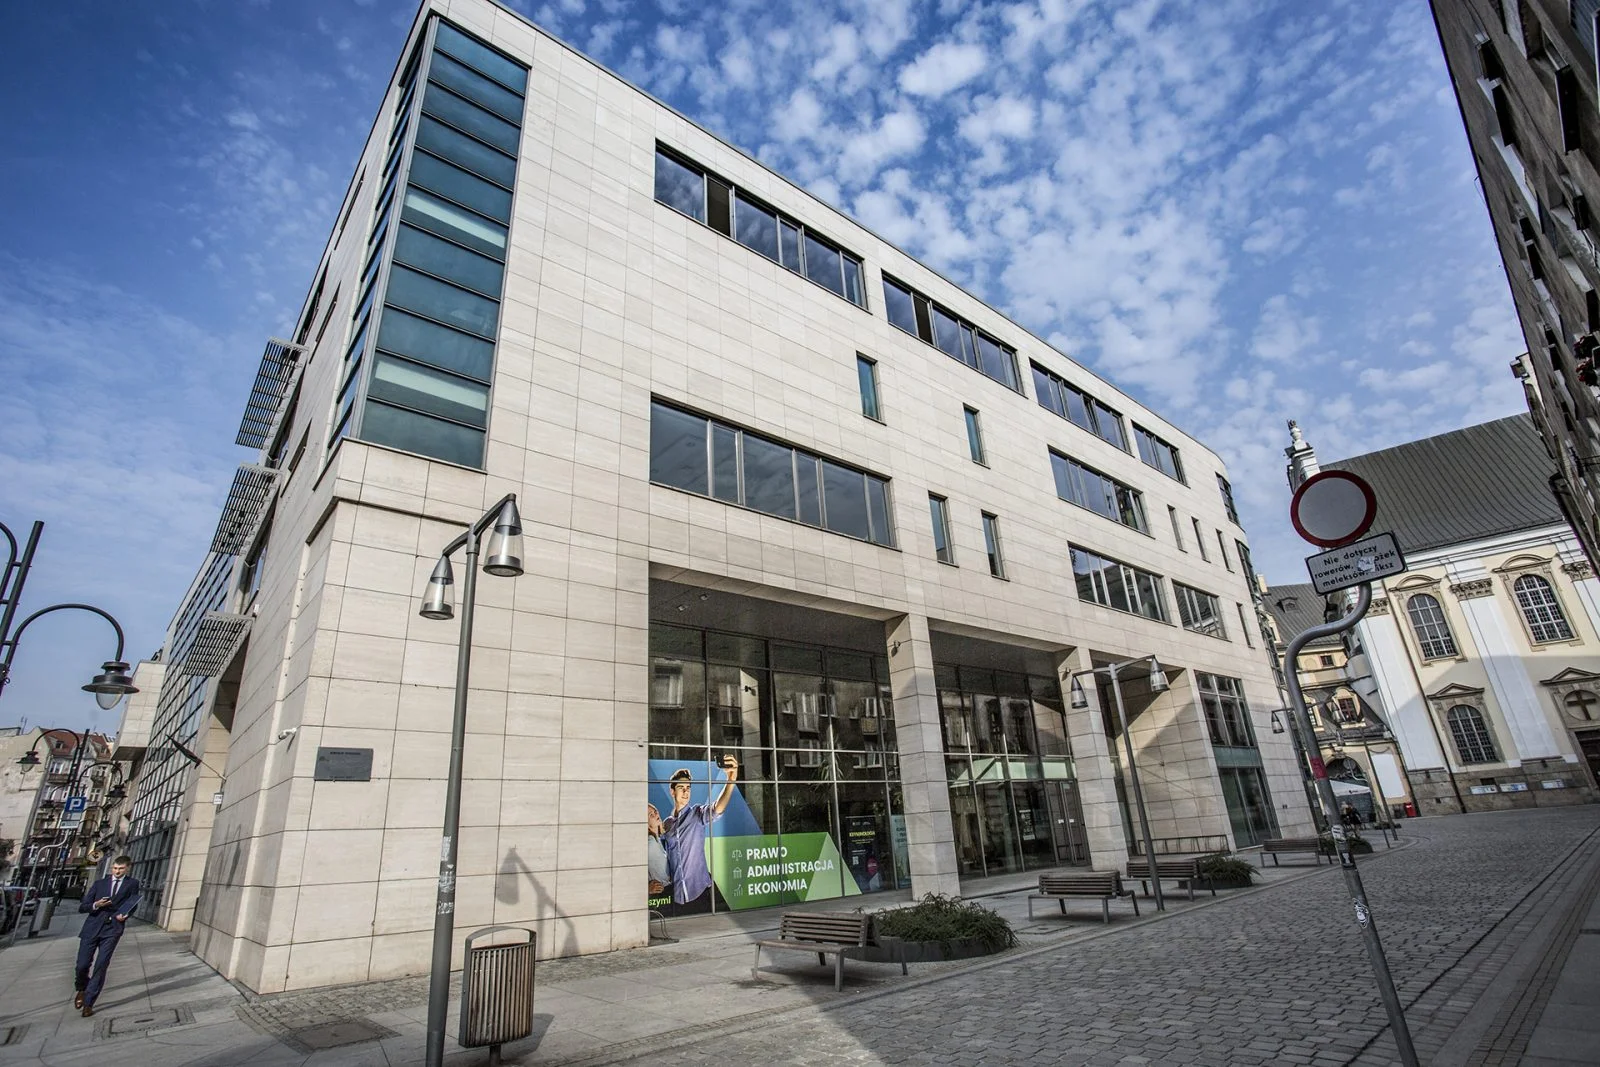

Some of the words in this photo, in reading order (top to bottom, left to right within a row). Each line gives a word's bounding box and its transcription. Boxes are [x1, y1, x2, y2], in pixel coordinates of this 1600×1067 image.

[1323, 556, 1339, 566] Nie
[1343, 545, 1377, 560] dotyczy
[1374, 562, 1394, 572] iksz
[69, 799, 81, 810] P
[746, 846, 788, 860] PRAWO
[747, 860, 834, 878] ADMINISTRACJA
[748, 878, 808, 896] EKONOMIA
